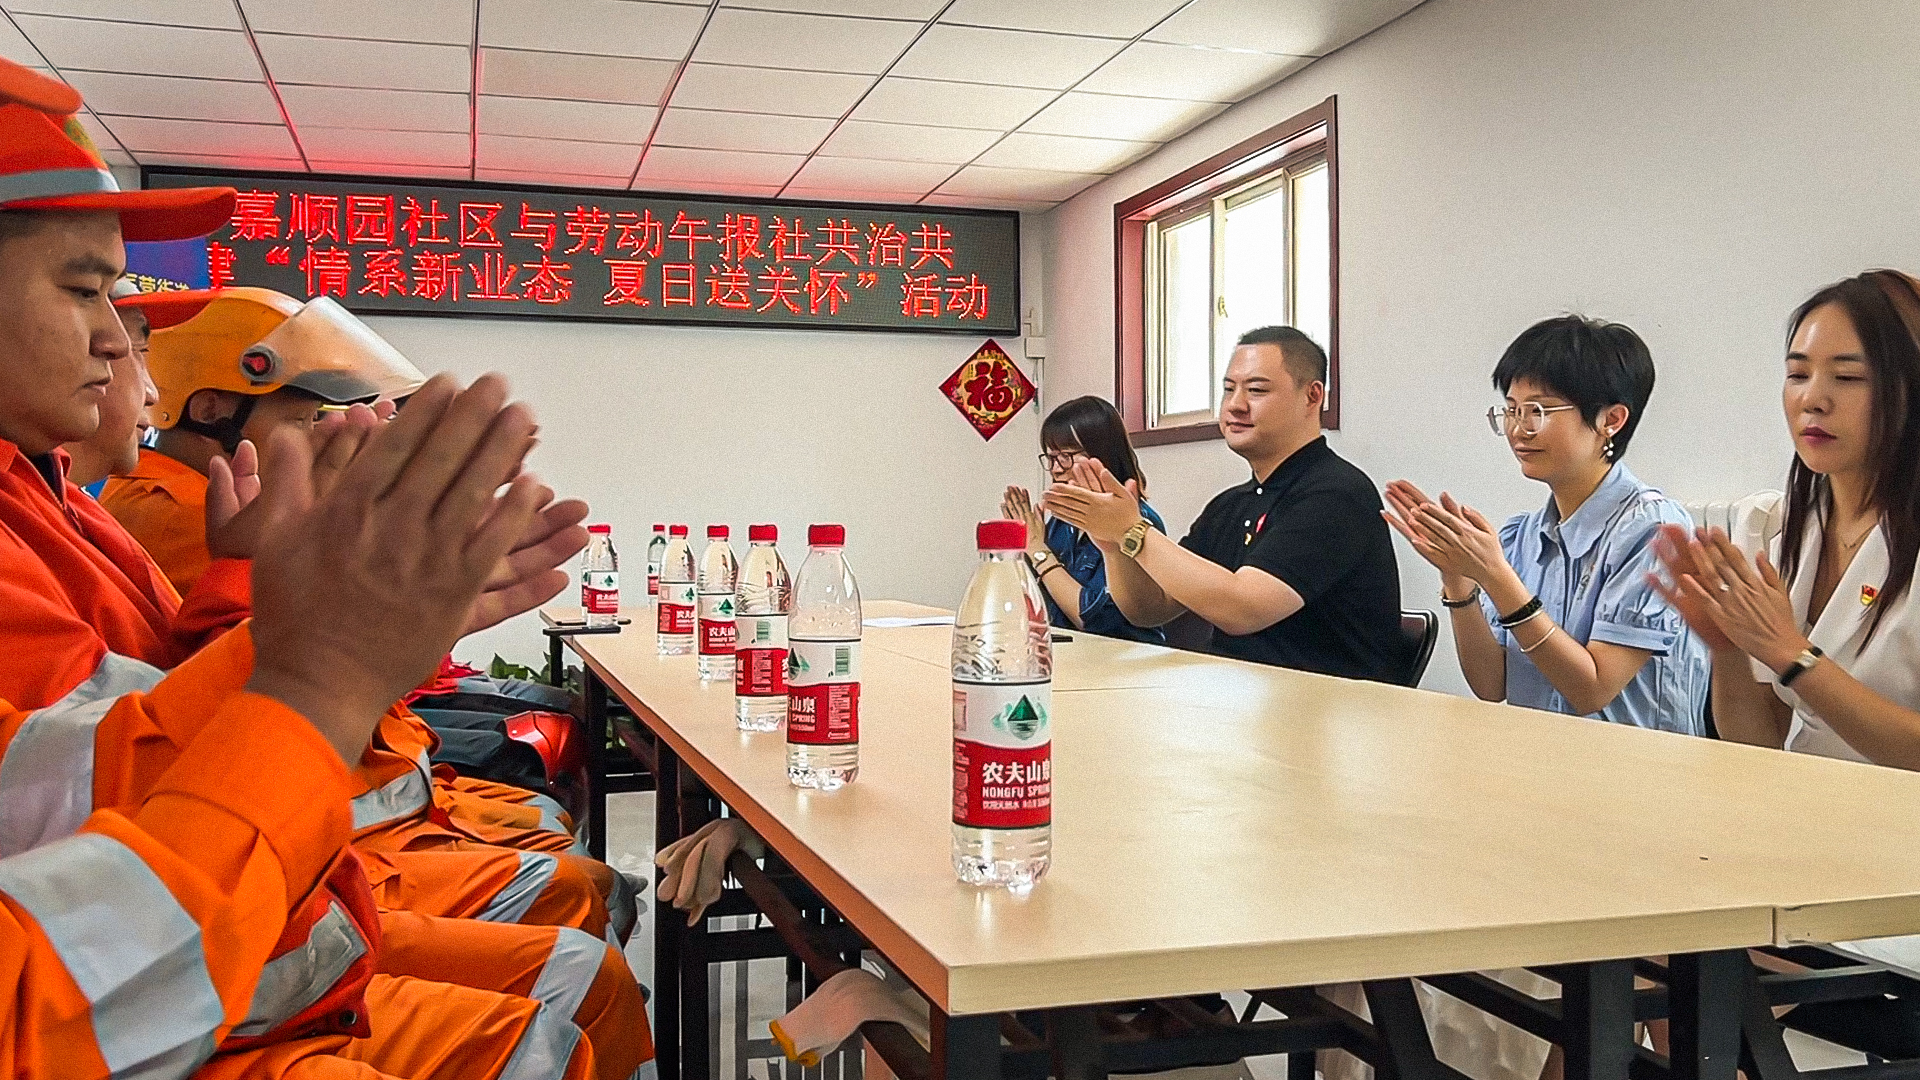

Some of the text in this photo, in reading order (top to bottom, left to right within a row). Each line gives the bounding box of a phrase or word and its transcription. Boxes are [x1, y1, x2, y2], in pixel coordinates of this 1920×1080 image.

[230, 189, 954, 270] 嘉顺园社区与劳动午报社共治共
[963, 360, 1014, 413] 福
[982, 786, 1025, 799] NONGFU
